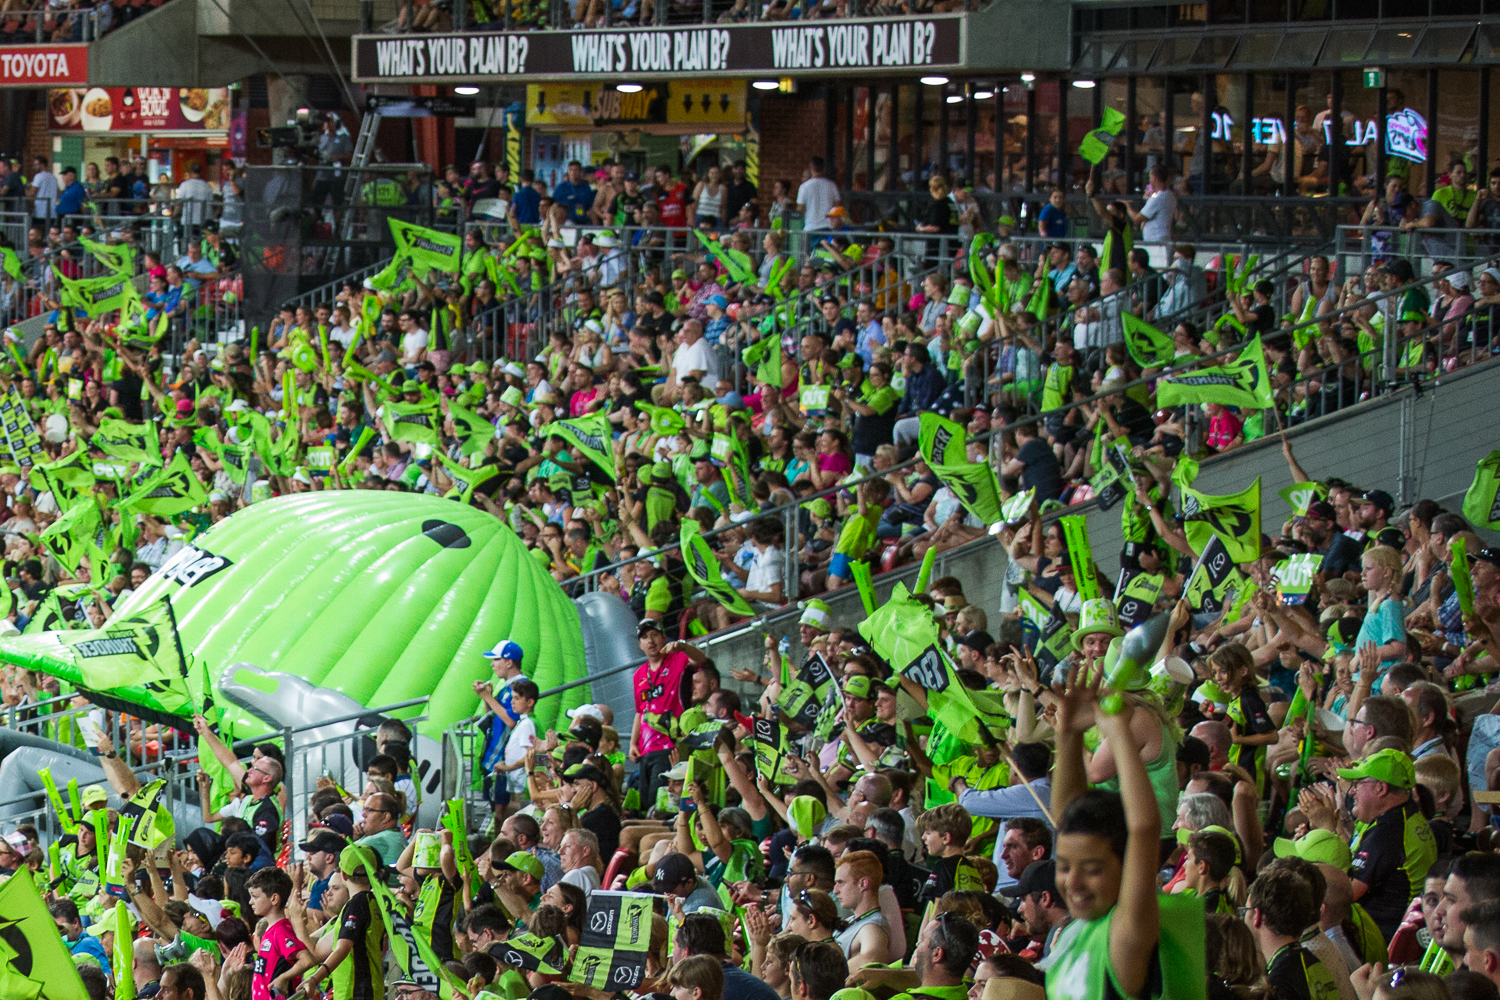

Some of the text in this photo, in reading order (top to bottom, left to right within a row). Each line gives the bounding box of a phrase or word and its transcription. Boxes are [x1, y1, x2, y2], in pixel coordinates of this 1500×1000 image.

[376, 35, 529, 76] WHAT'S YOUR PLAN B?
[571, 29, 731, 72] WHAT'S YOUR PLAN B?
[772, 22, 936, 68] WHAT'S YOUR PLAN B?
[1, 53, 70, 78] TOYOTA
[802, 389, 827, 406] OUT
[310, 451, 332, 467] OUT
[1281, 562, 1315, 587] OUT
